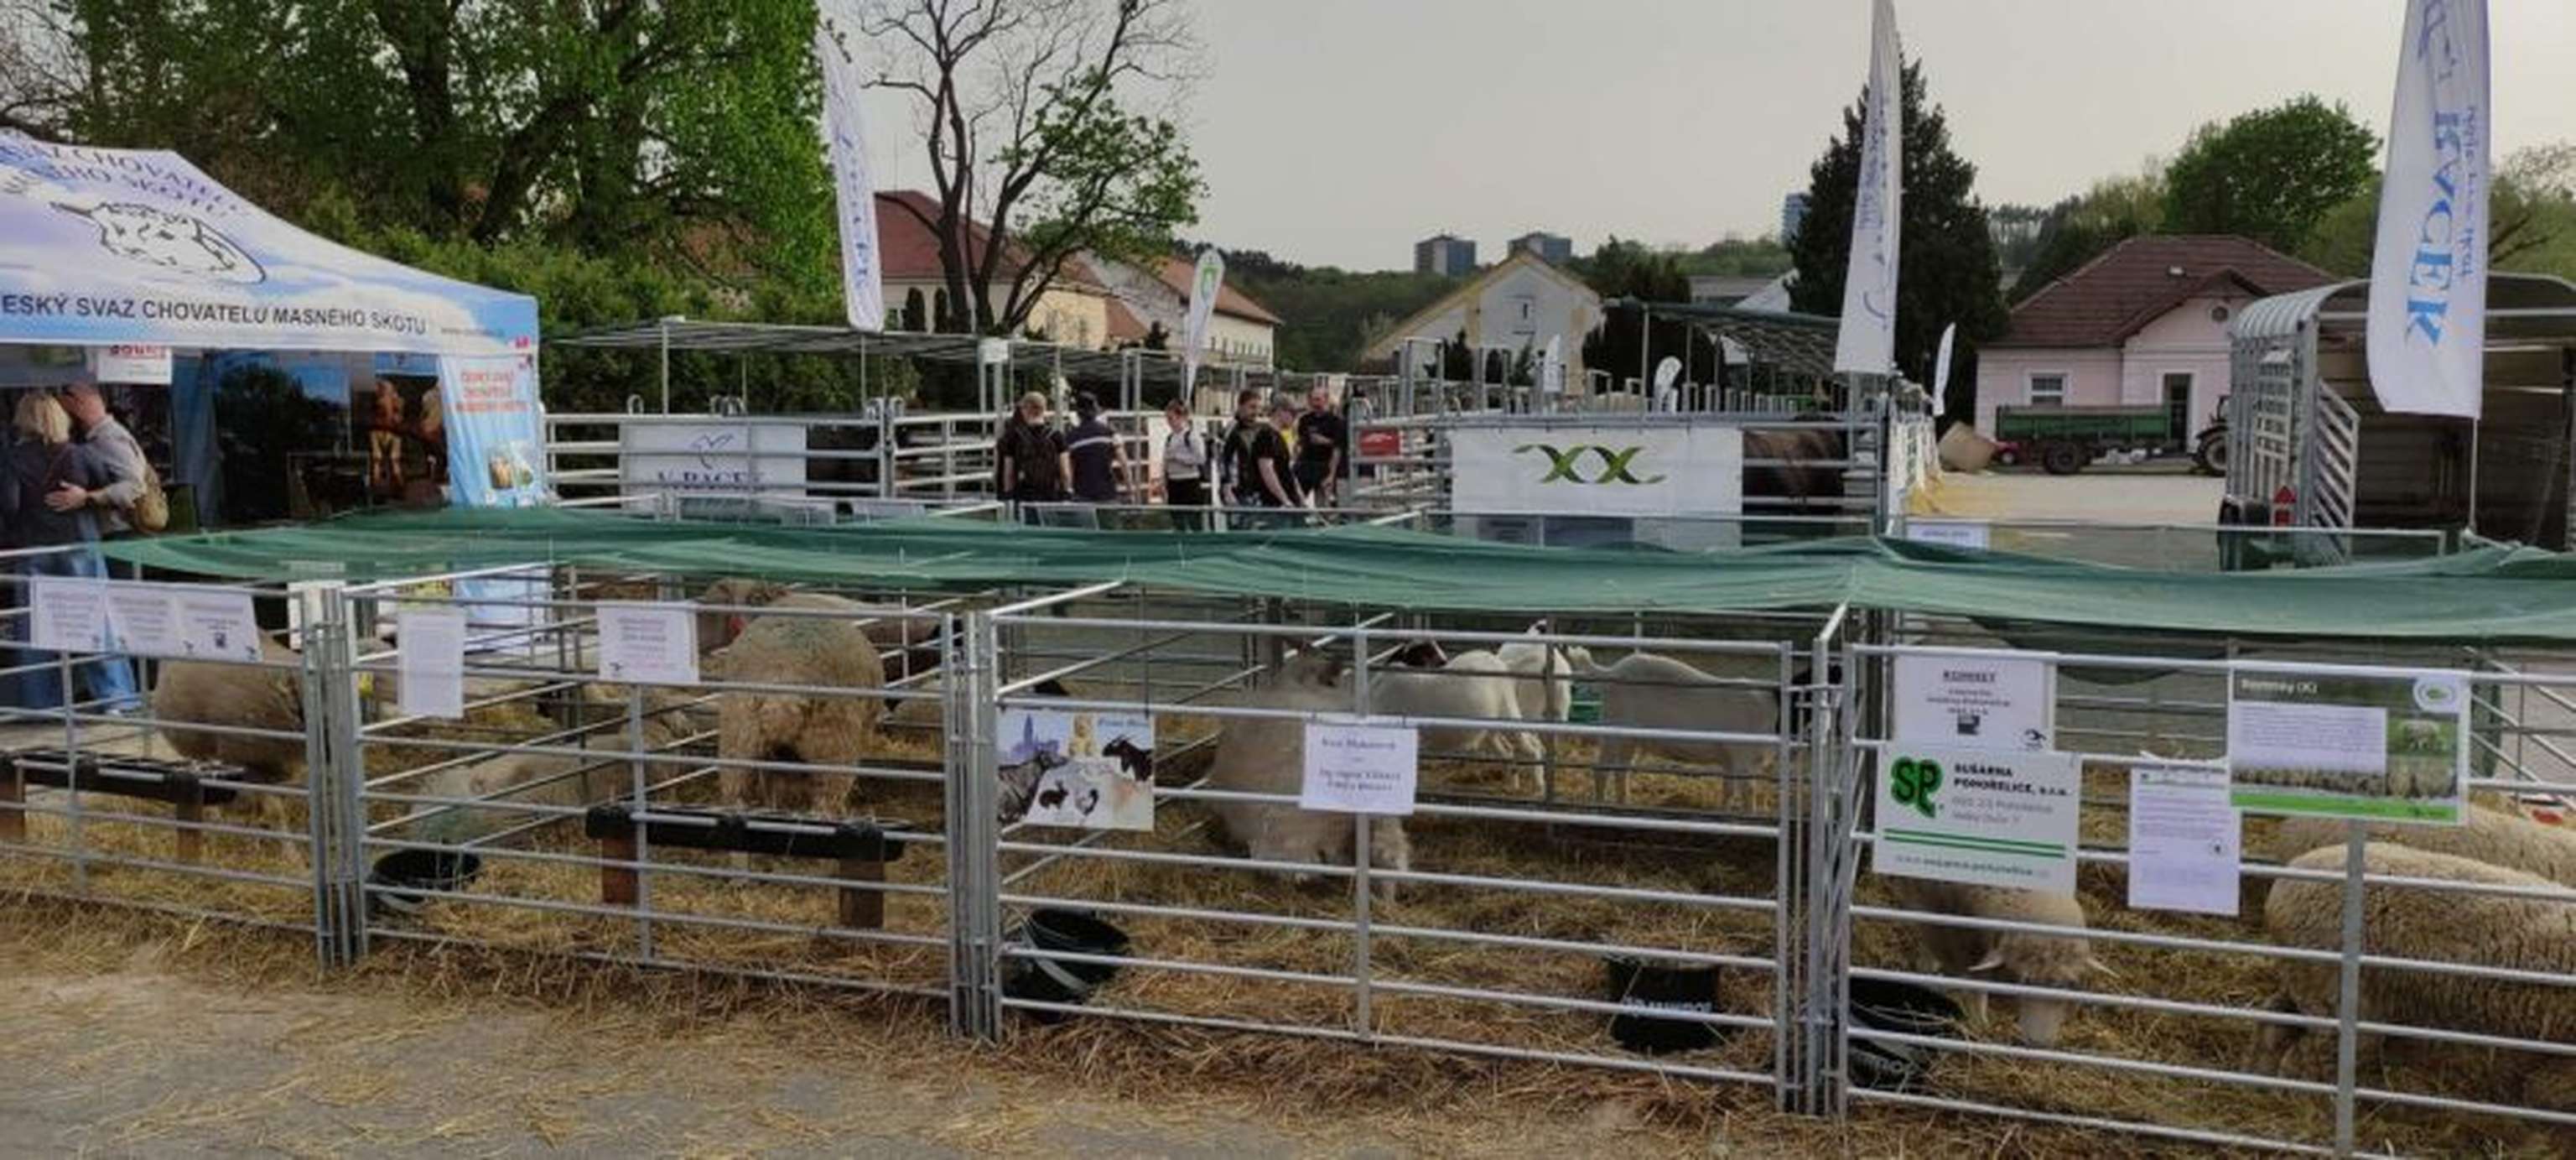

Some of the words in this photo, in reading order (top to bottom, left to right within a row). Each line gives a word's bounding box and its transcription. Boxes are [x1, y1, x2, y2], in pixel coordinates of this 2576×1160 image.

[3, 293, 69, 315] ESKÝ
[75, 297, 135, 319] SVAZ
[370, 311, 426, 335] SKOTU
